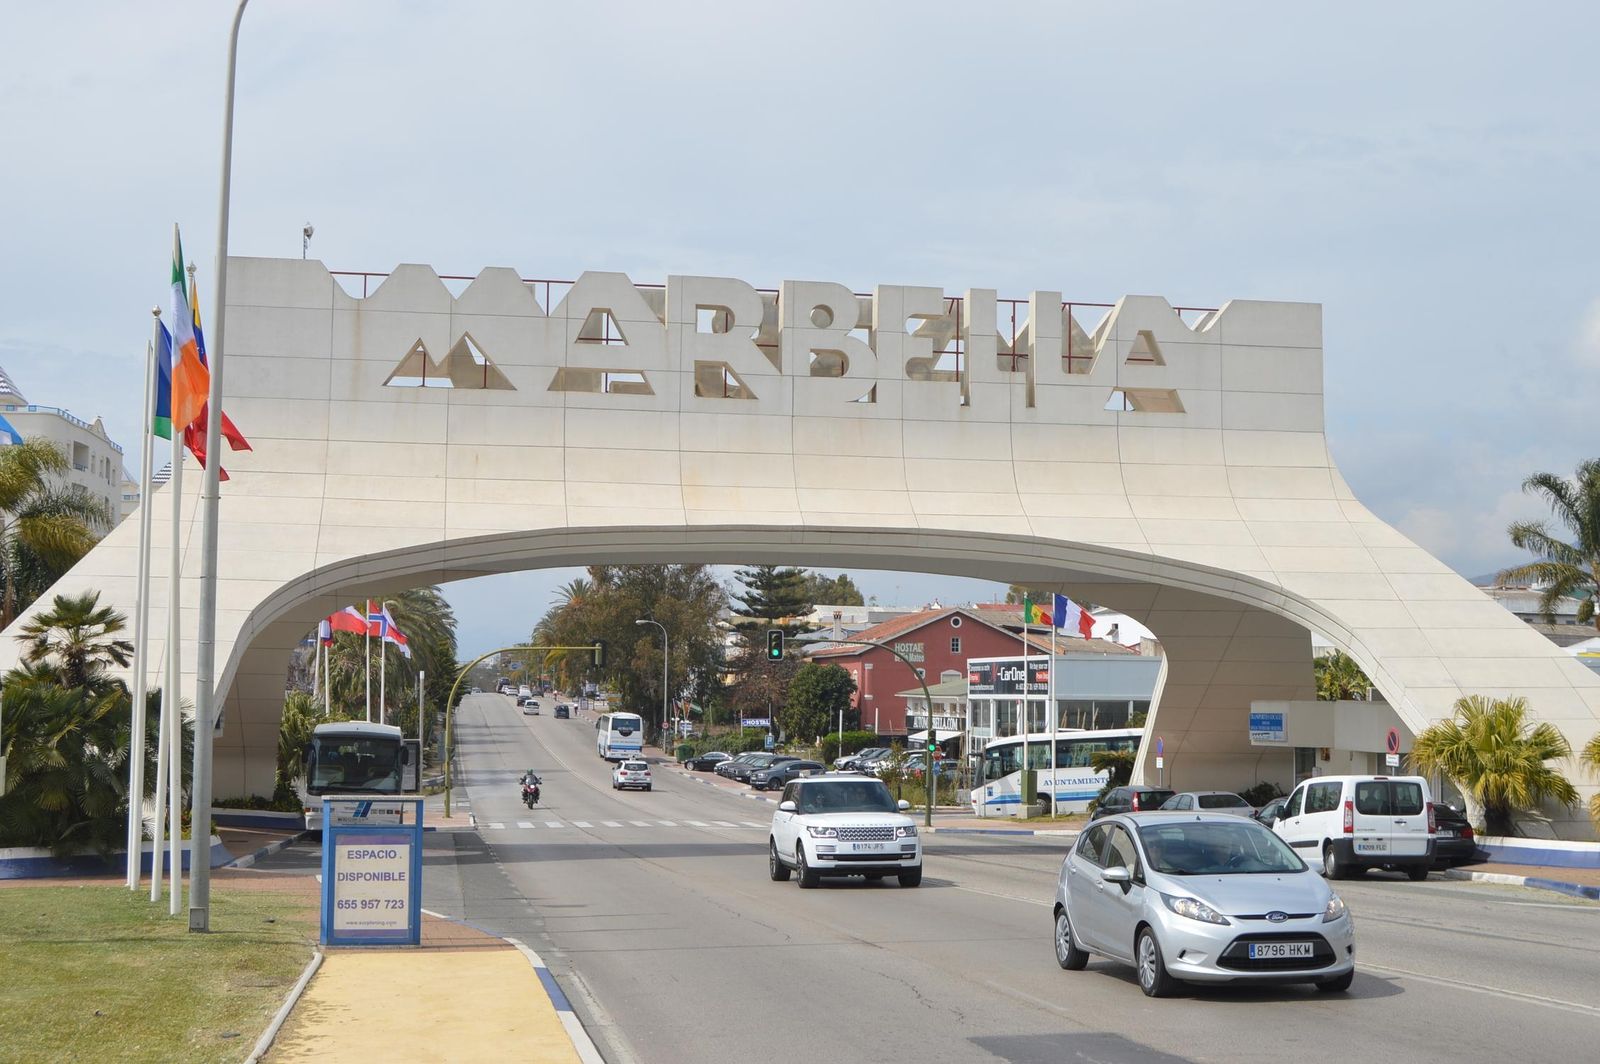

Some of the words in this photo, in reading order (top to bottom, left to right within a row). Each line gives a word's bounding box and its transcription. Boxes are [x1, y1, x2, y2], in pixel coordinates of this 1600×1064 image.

[362, 263, 1204, 412] MARBELLA
[894, 642, 924, 652] HOSTAL
[347, 849, 397, 860] ESPACIO
[337, 872, 406, 882] DISPONIBLE
[337, 899, 358, 910] 655
[360, 899, 381, 910] 957
[384, 899, 404, 909] 723
[1257, 945, 1286, 956] 8796
